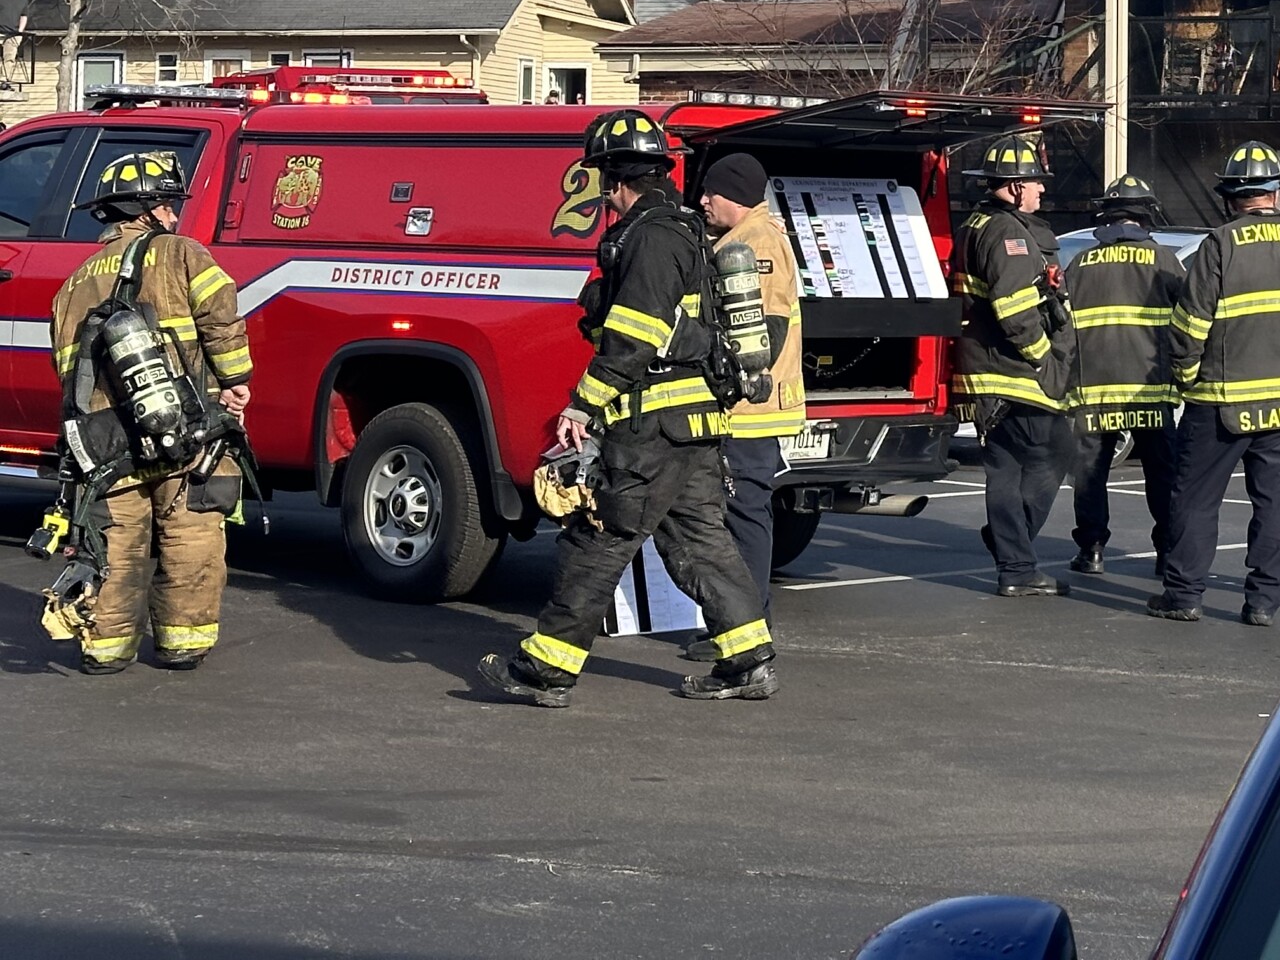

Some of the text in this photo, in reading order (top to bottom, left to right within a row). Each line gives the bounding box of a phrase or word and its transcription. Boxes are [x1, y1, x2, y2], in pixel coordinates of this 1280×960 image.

[551, 158, 604, 239] 2
[272, 213, 301, 229] STATION
[1078, 245, 1155, 268] LEXINGTON
[68, 247, 156, 292] LXINGN
[331, 267, 501, 290] DISTRICT OFFICER
[732, 310, 761, 324] MSA
[687, 413, 704, 438] W
[1085, 410, 1163, 431] T. MERIDETH
[1239, 411, 1256, 431] S.
